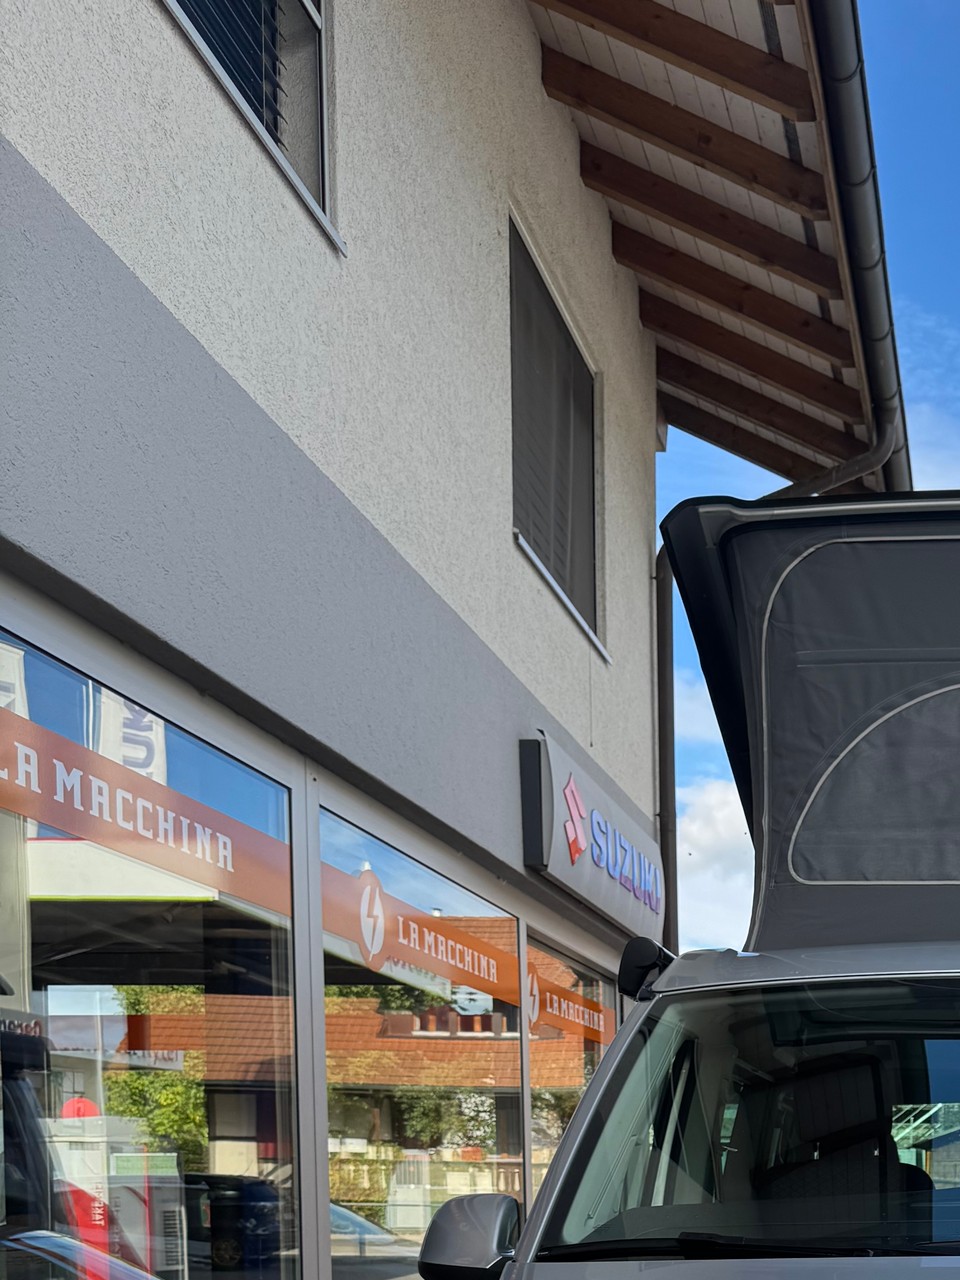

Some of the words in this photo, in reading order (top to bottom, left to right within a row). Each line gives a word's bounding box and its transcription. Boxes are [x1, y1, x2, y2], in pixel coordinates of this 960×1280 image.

[122, 700, 156, 777] UK
[53, 758, 235, 873] MACCHINA
[591, 808, 662, 916] SUZUKI
[397, 914, 421, 951] LA
[422, 926, 498, 984] MACCHINA
[545, 991, 560, 1016] LA
[560, 997, 605, 1033] MACCHINA
